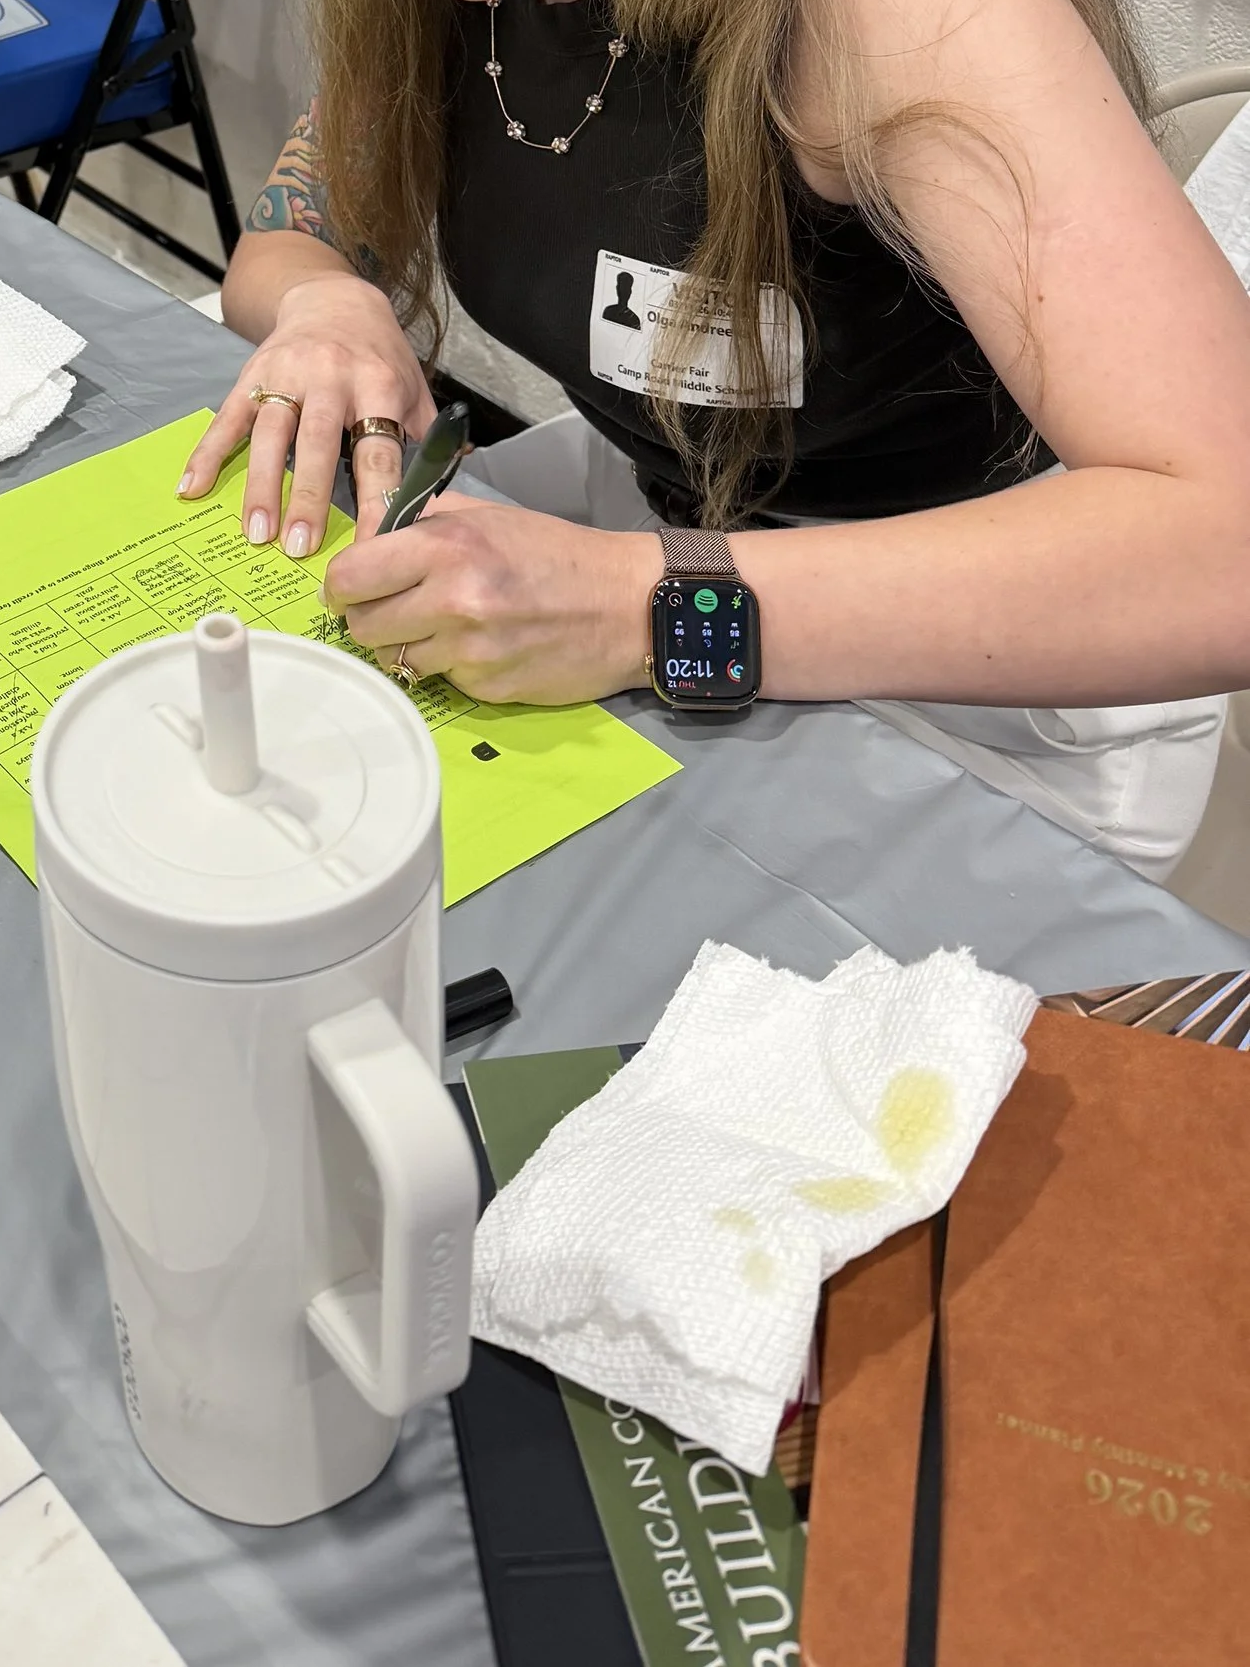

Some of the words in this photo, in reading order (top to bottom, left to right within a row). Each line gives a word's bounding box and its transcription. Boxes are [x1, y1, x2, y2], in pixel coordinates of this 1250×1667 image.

[617, 363, 642, 382] Camp
[689, 366, 710, 378] Fair
[706, 398, 733, 407] RAPTOR
[185, 504, 222, 522] Reminder:
[157, 522, 185, 535] Visitors
[139, 534, 156, 544] must
[214, 539, 233, 549] chose
[123, 543, 138, 552] sign
[106, 550, 122, 561] your
[233, 551, 246, 559] Ask
[83, 560, 104, 571] Bingo
[57, 570, 81, 583] square
[277, 573, 293, 581] their
[35, 585, 46, 594] get
[267, 573, 308, 596] professional
[12, 593, 33, 604] credit
[85, 585, 118, 602] achieving
[151, 590, 165, 598] that
[251, 594, 267, 602] who
[282, 589, 300, 599] Find
[185, 596, 207, 607] booth
[63, 602, 84, 613] career
[76, 606, 95, 617] about
[90, 596, 131, 620] professional
[168, 605, 184, 616] prop
[107, 611, 120, 619] Ask
[9, 622, 41, 636] children.
[29, 627, 52, 637] works
[136, 625, 167, 640] business
[12, 637, 29, 645] with
[26, 626, 69, 649] professional
[9, 648, 24, 656] who
[40, 642, 57, 653] Find
[60, 666, 83, 677] home.
[666, 658, 714, 679] 11:20
[668, 680, 677, 688] 12
[678, 680, 696, 689] THU
[9, 705, 28, 717] what
[18, 723, 33, 734] Ask
[1084, 1467, 1214, 1536] 2026
